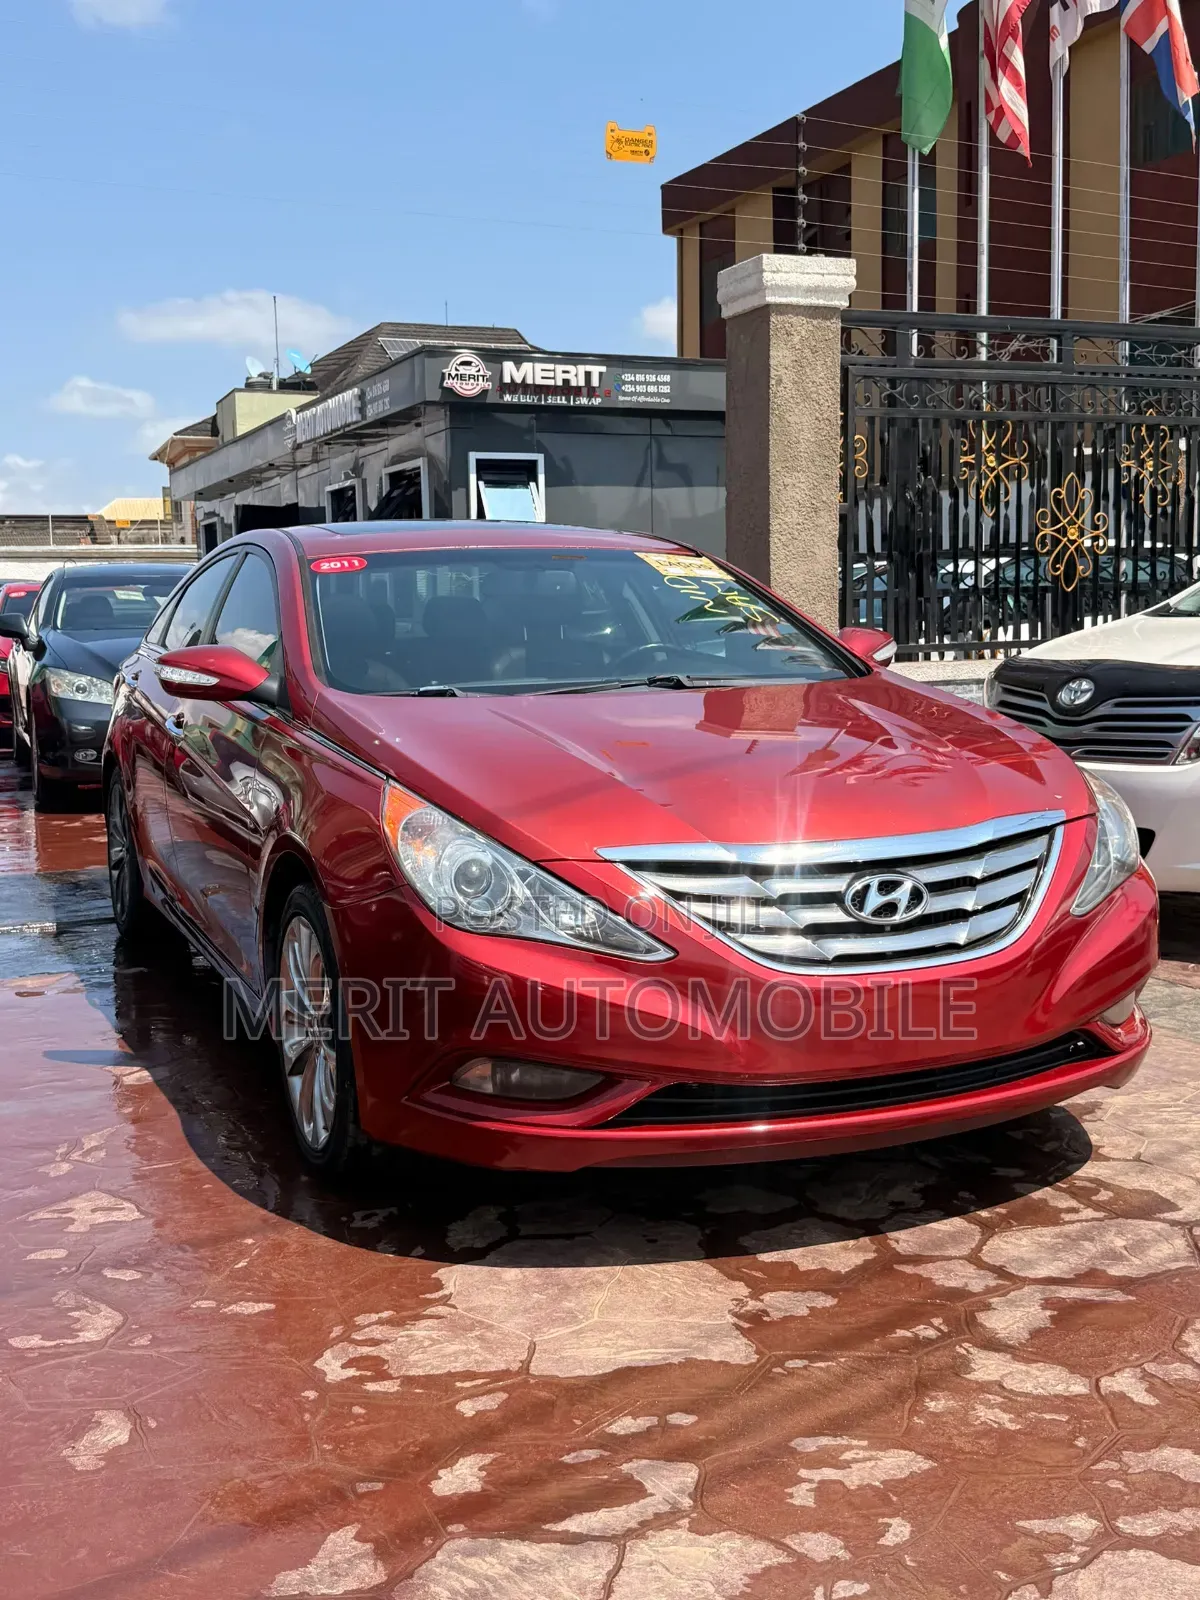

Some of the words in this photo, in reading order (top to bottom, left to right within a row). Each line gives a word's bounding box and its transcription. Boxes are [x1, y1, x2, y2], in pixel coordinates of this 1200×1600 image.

[624, 137, 653, 145] DANGER
[447, 372, 488, 383] MERIT
[502, 361, 607, 387] MERIT
[503, 394, 519, 402] WE
[520, 395, 539, 403] BUY
[547, 396, 567, 404] SELL
[575, 397, 602, 405] SWAP
[320, 559, 361, 570] 2011
